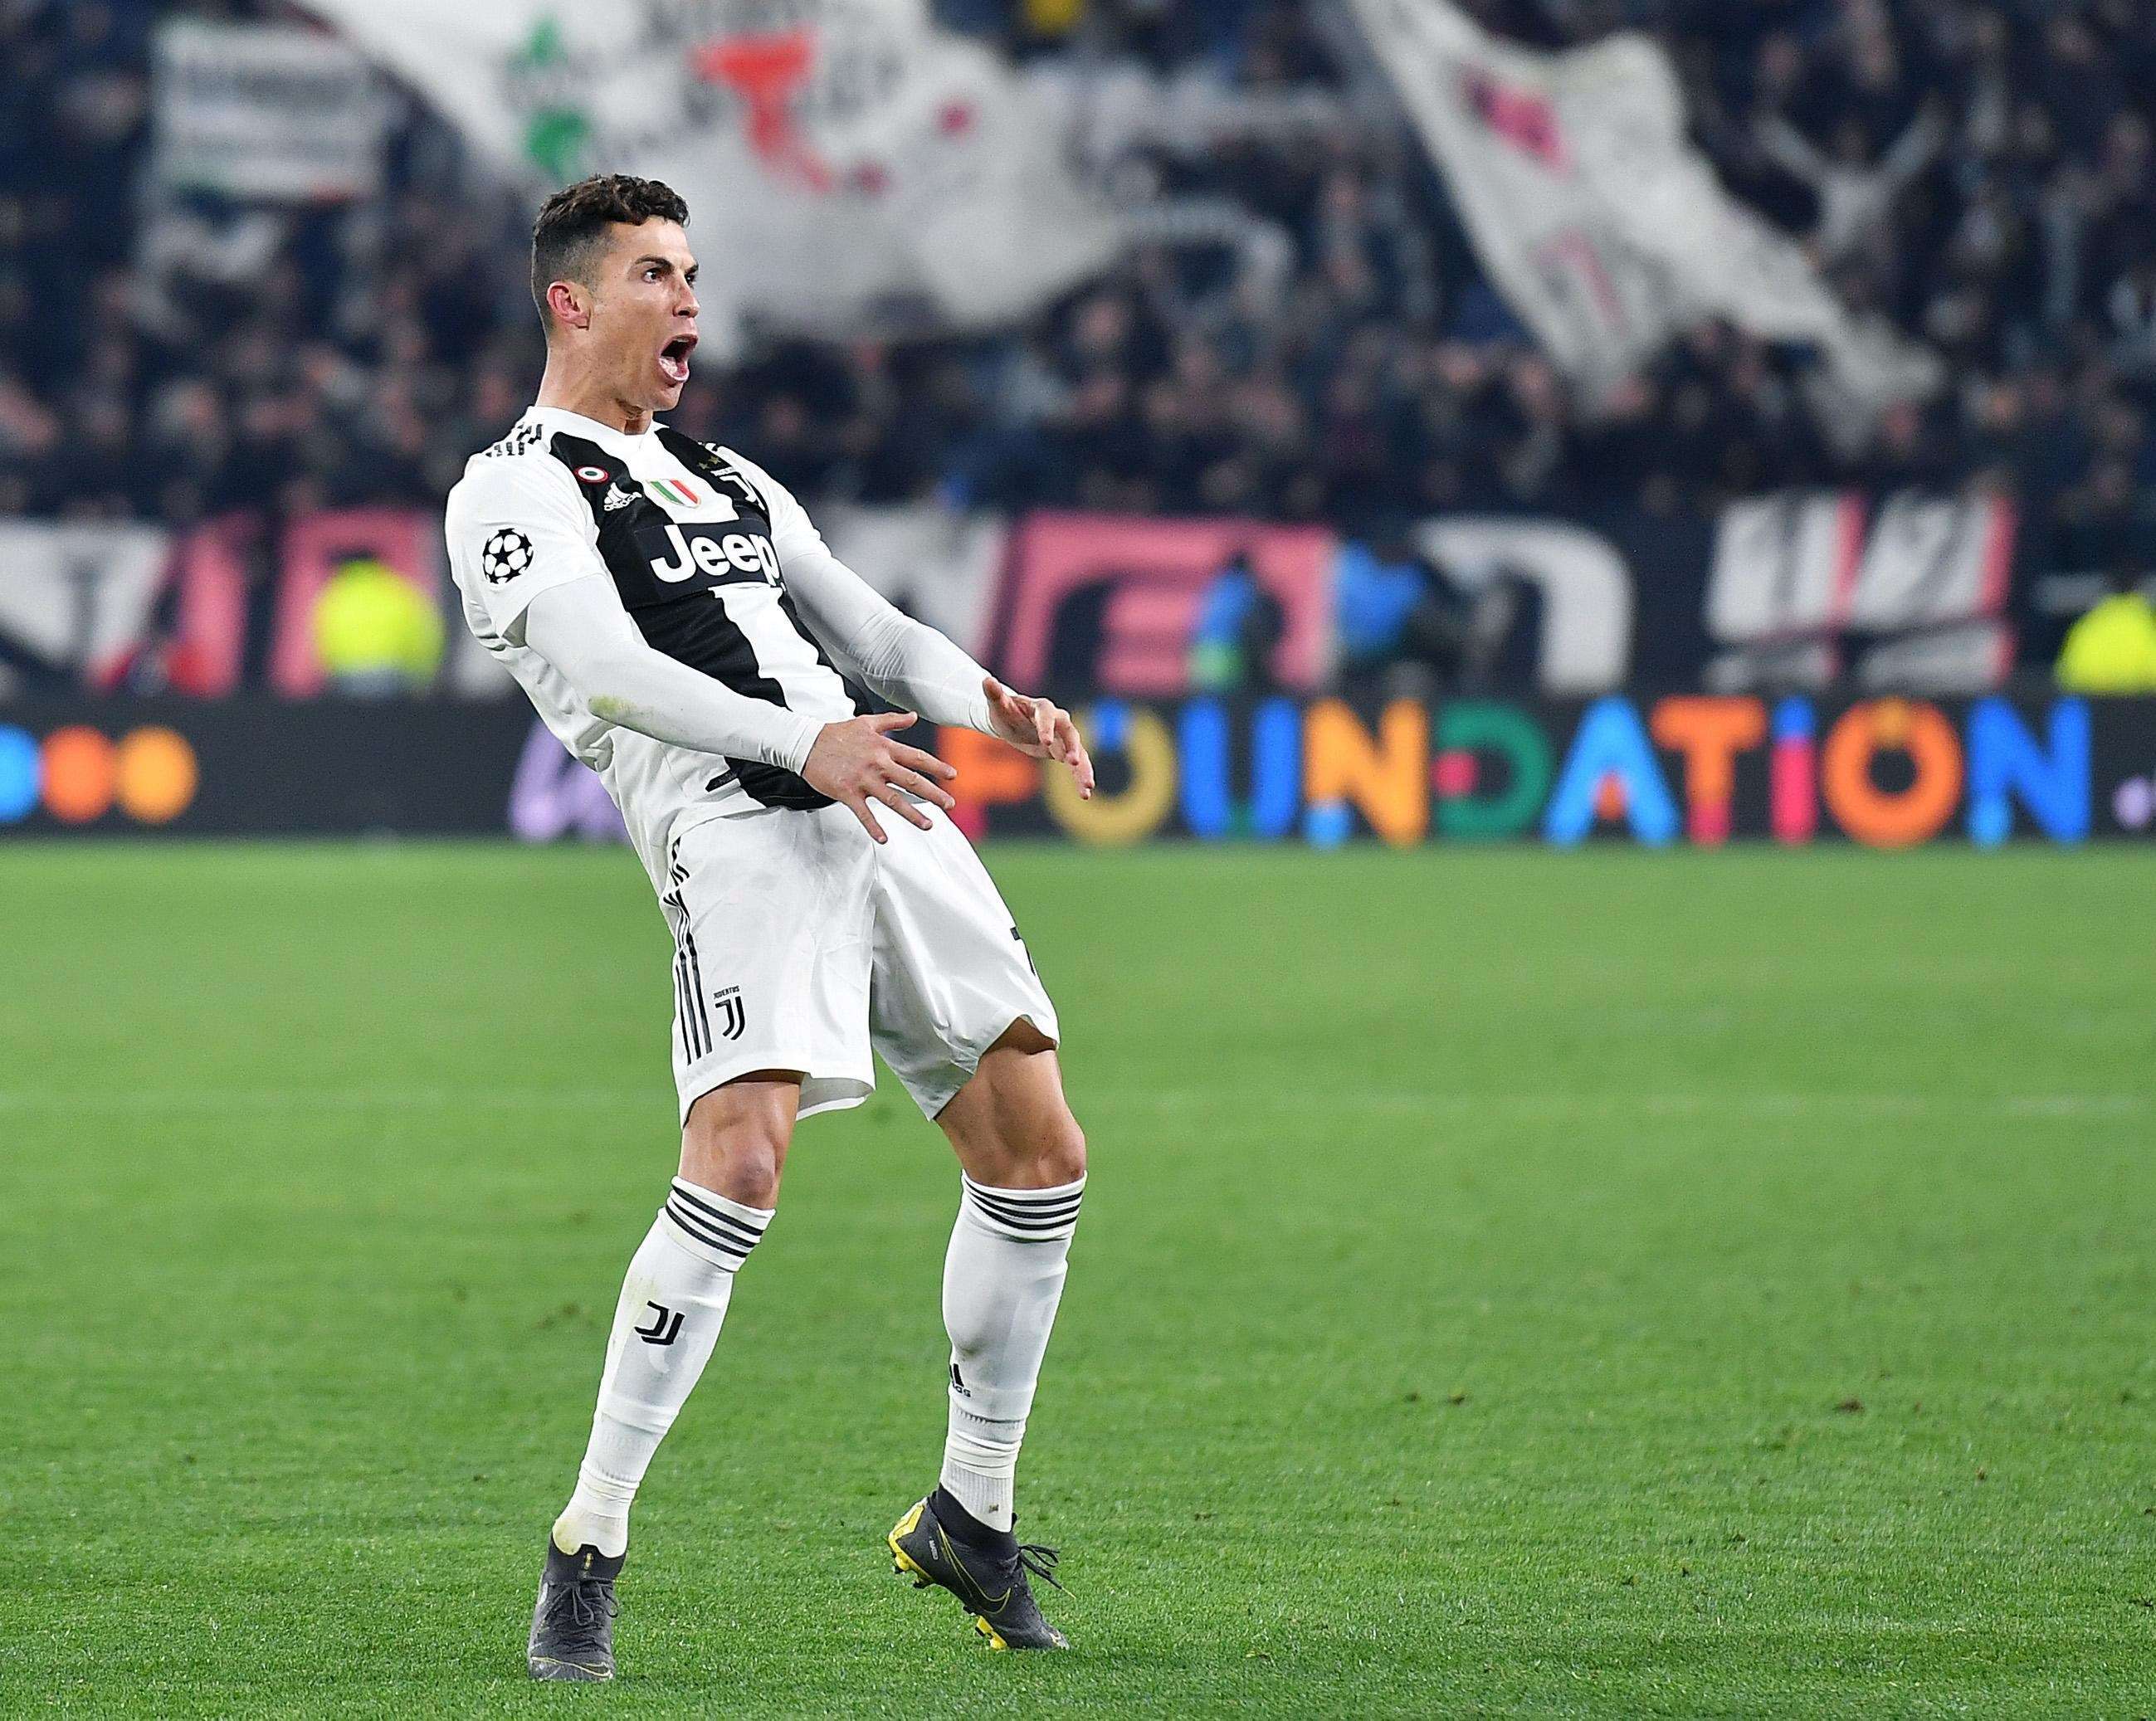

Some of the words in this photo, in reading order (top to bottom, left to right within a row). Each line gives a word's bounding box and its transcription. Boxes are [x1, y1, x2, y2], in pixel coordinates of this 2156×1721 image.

[604, 491, 642, 511] adidas
[650, 524, 780, 587] Jeep
[936, 694, 2093, 850] FOUNDATION
